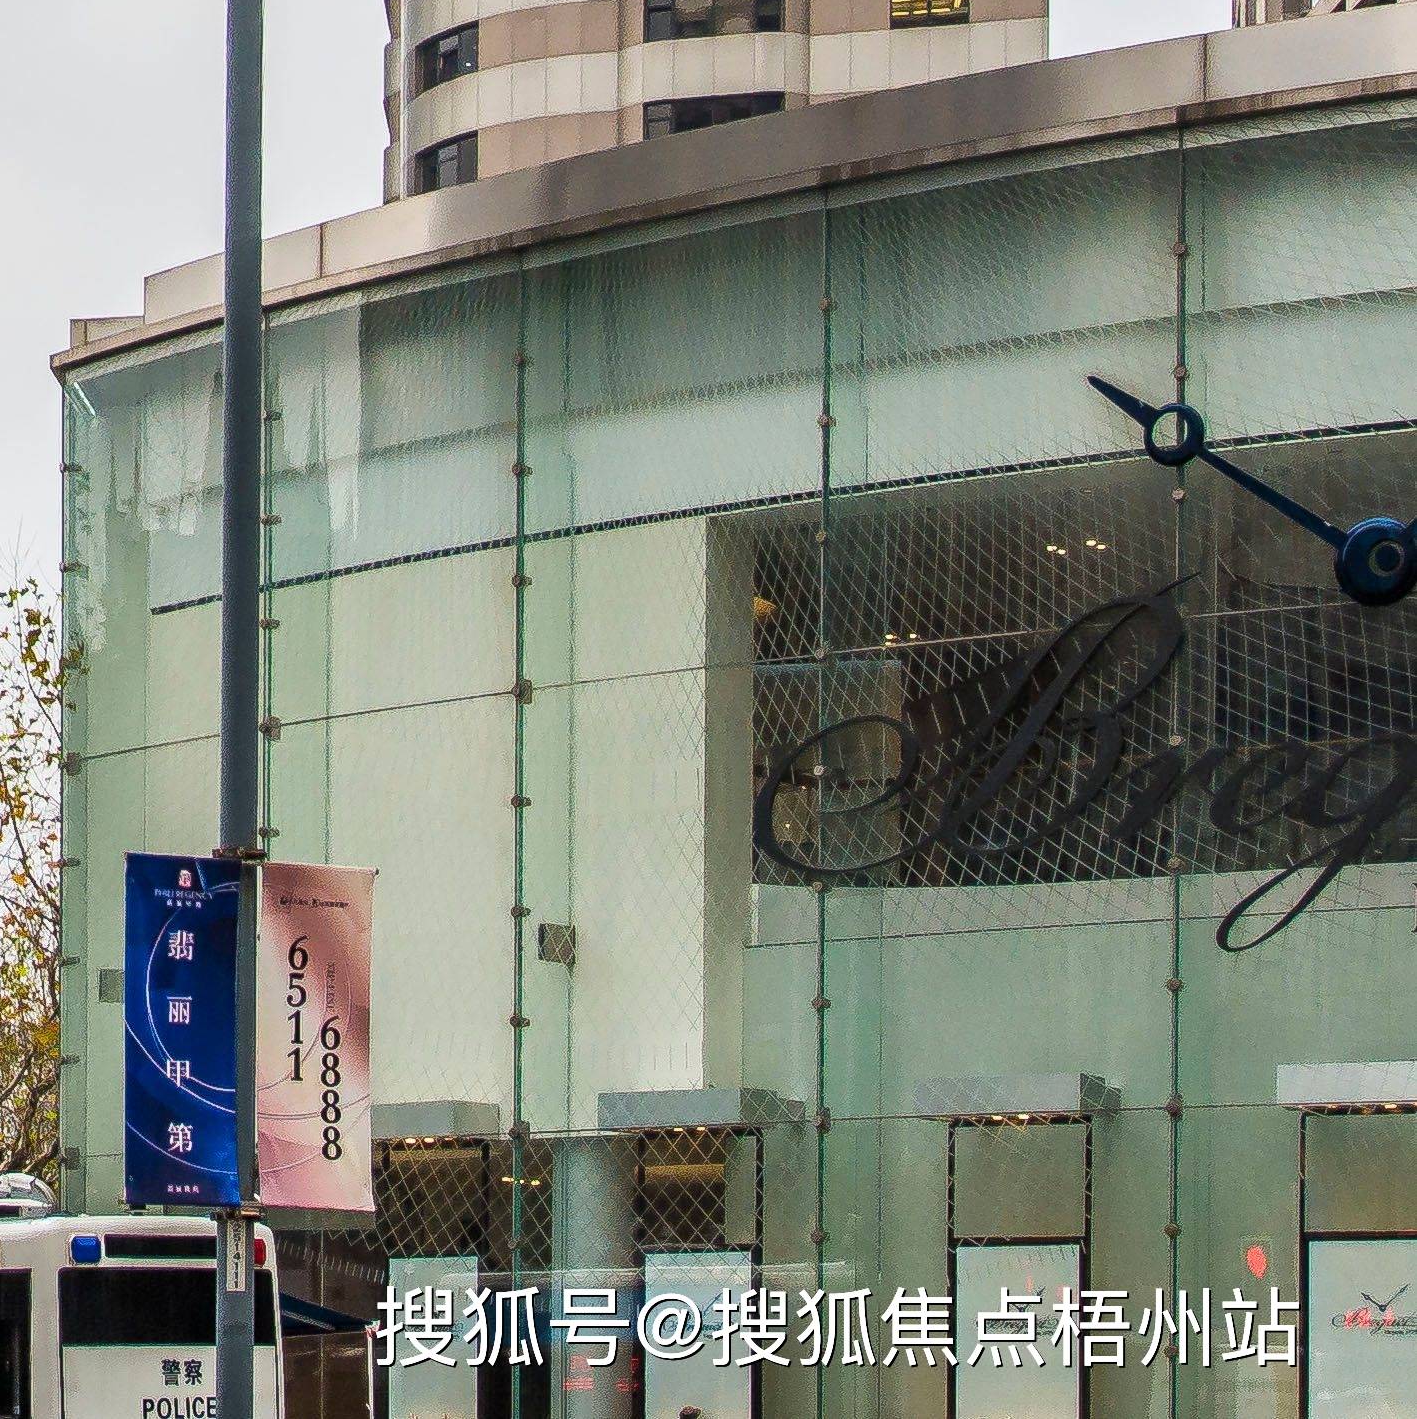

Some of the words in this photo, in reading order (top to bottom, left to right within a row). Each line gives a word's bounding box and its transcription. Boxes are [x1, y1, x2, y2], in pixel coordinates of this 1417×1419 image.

[167, 929, 195, 1153] 翡丽甲第
[286, 935, 309, 1082] 6511
[319, 1015, 343, 1161] 6888
[142, 1396, 217, 1419] POLICE
[161, 1359, 203, 1387] 警察
